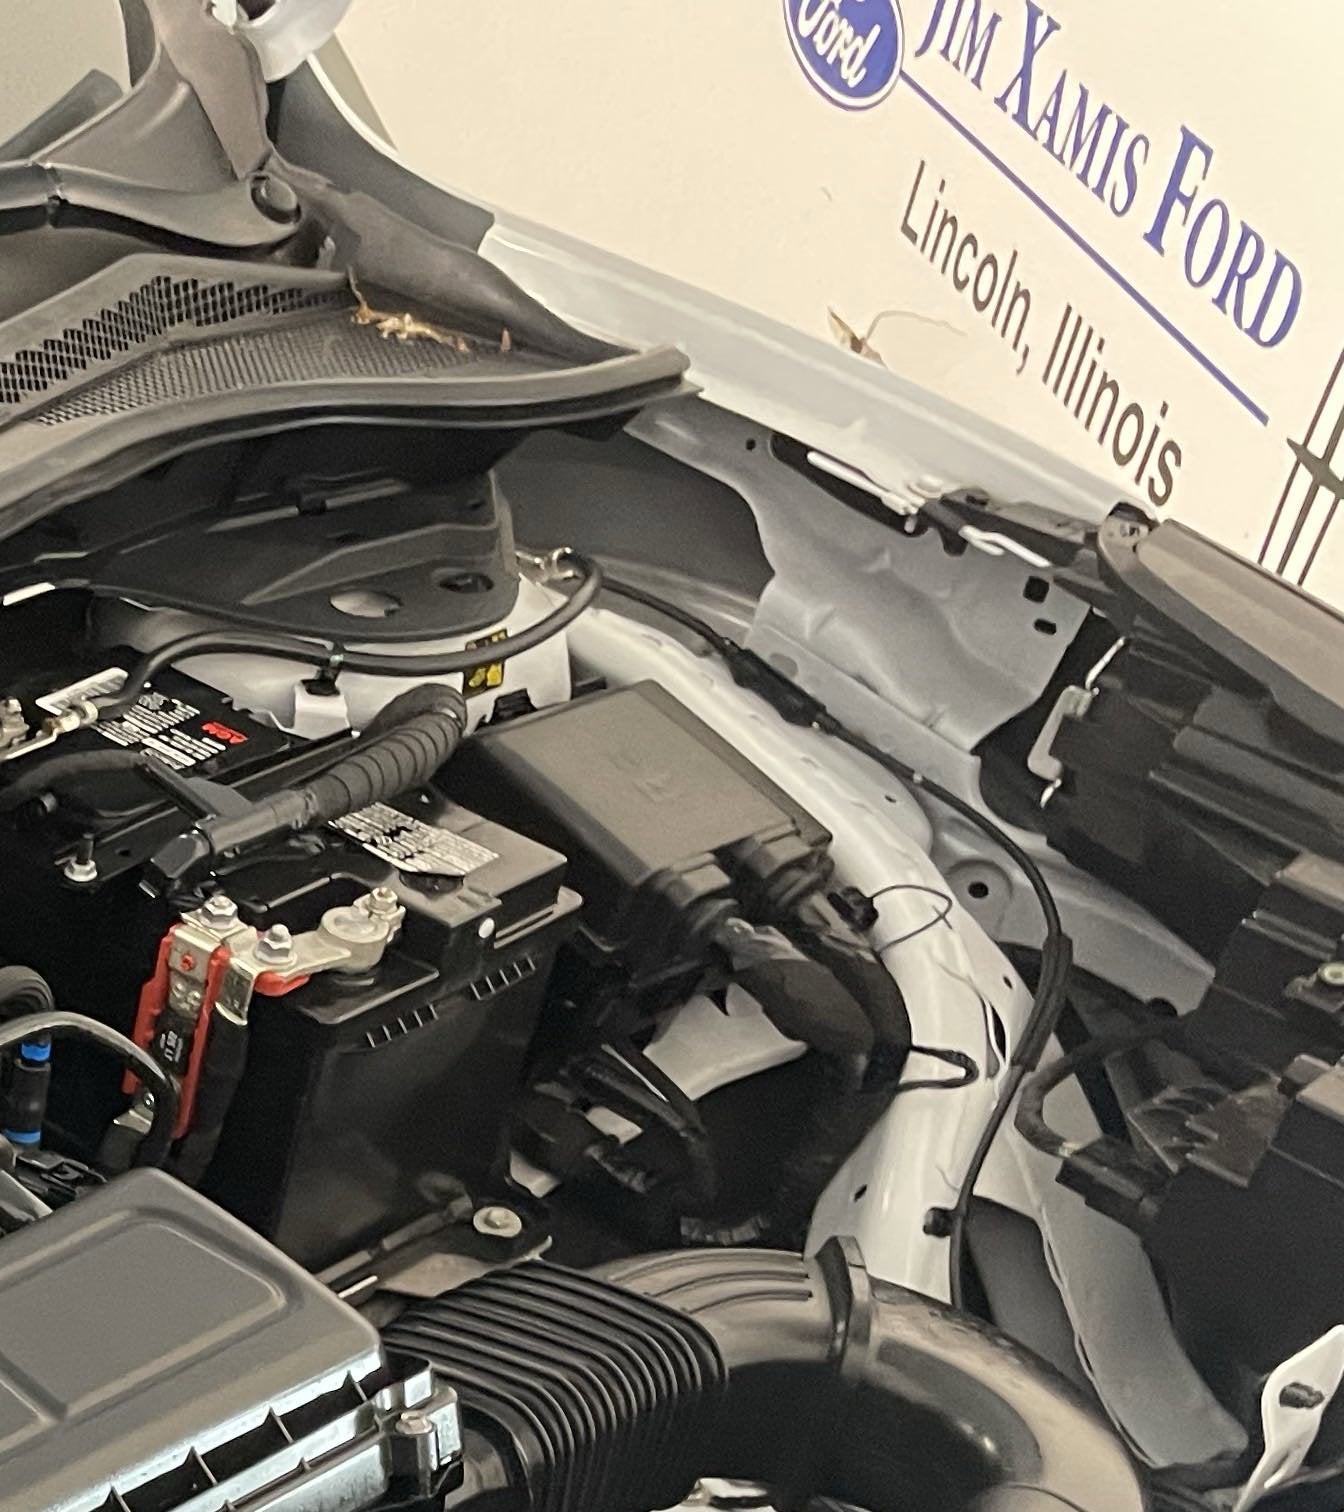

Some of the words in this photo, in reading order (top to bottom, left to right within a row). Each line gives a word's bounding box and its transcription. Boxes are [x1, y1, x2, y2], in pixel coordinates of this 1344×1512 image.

[900, 160, 1031, 375] Lincoln,
[1042, 302, 1182, 507] Illinois
[914, 0, 1003, 91] JIM
[993, 0, 1149, 218] XAMIS
[1143, 125, 1303, 349] FORD
